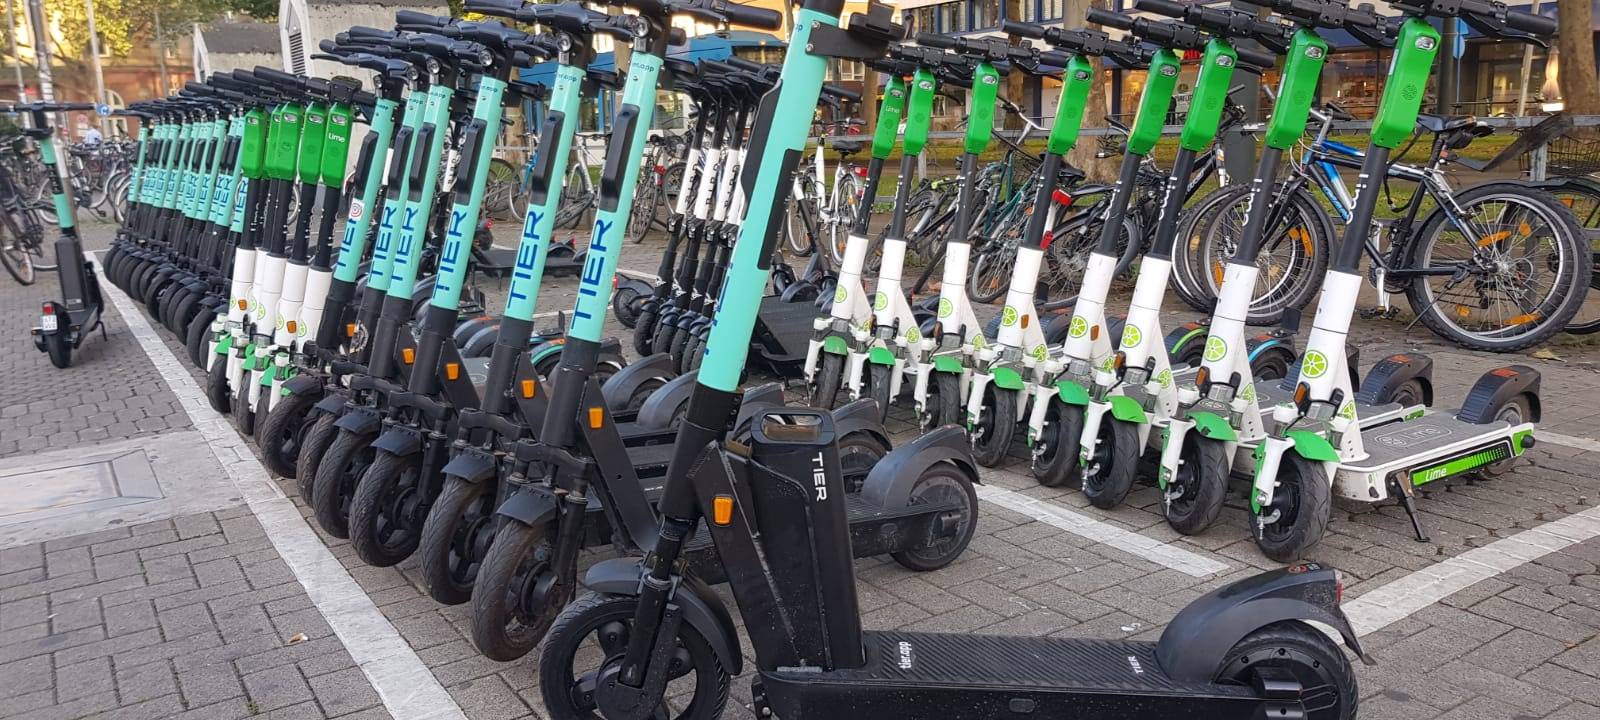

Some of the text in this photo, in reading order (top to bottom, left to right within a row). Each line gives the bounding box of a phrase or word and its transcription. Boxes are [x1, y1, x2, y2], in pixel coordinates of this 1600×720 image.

[328, 132, 345, 143] Lime
[370, 206, 397, 280] TIER
[391, 207, 419, 281] TIER
[433, 210, 467, 299] TIER
[507, 210, 544, 309] TIER
[570, 219, 613, 330] TIER
[811, 451, 827, 502] TIER
[1425, 467, 1448, 482] Lime
[897, 641, 913, 669] tier.app
[1127, 655, 1144, 674] TIER
